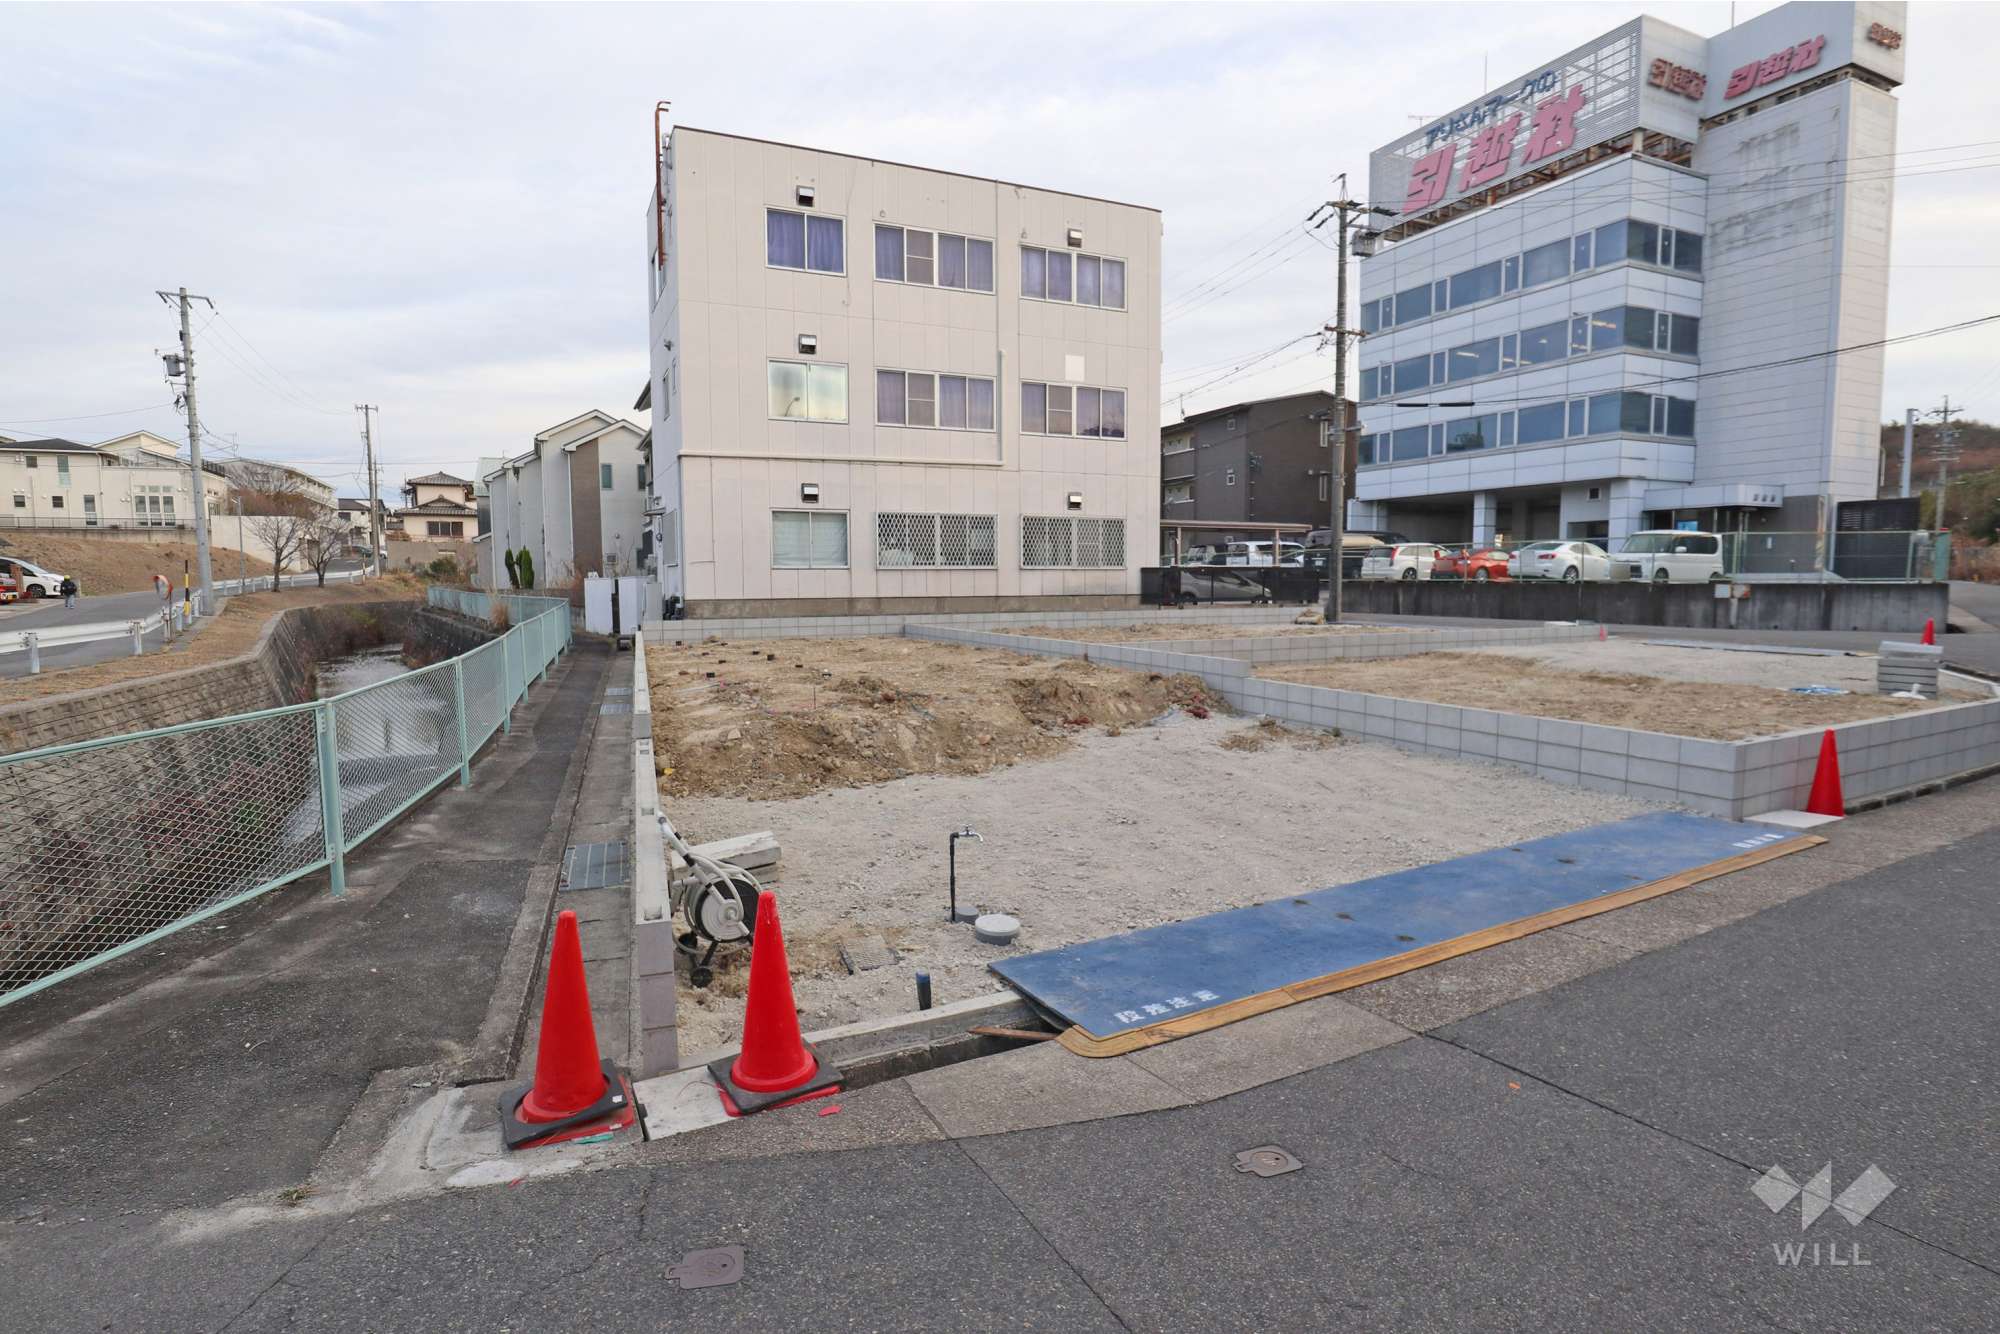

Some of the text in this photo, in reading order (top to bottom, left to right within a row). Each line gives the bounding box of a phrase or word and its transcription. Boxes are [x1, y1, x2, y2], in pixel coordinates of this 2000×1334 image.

[1724, 34, 1826, 100] 引越社
[1425, 69, 1558, 149] アリさんマークの
[1402, 84, 1586, 215] 引越社
